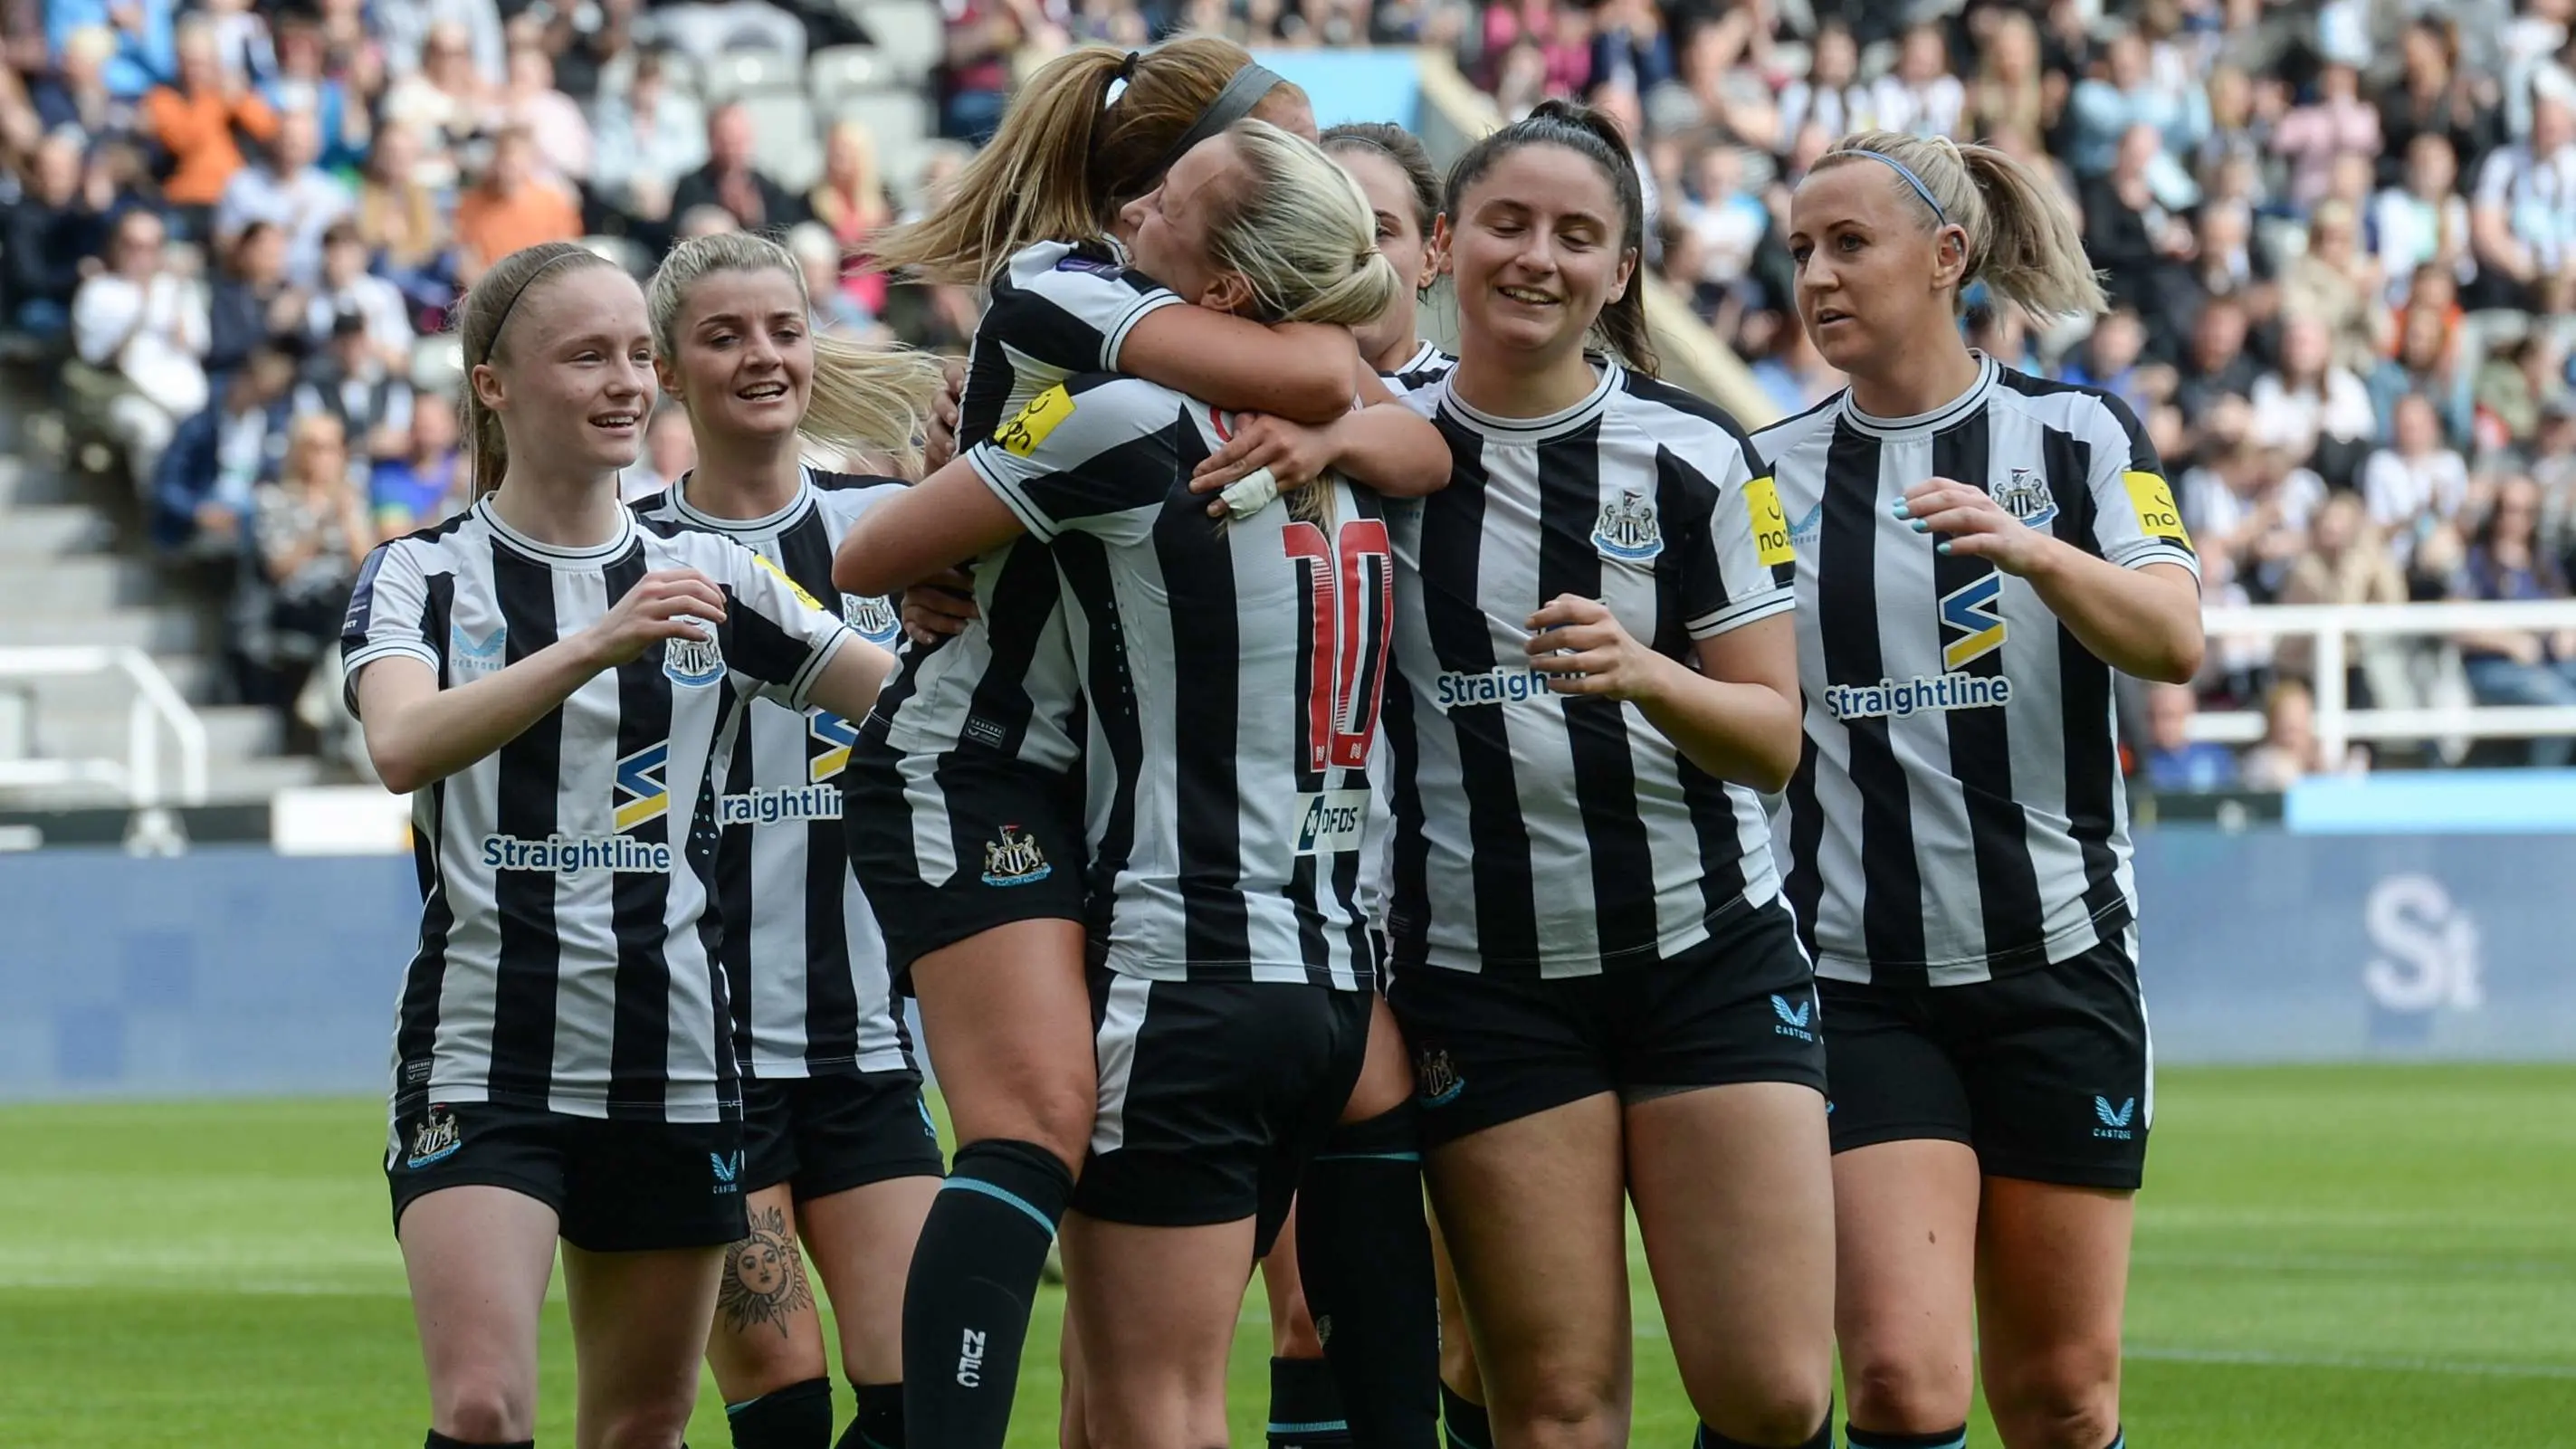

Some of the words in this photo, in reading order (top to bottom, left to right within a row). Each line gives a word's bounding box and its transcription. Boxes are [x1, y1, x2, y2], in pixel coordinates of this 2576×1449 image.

[2142, 512, 2177, 527] no
[1759, 530, 1786, 552] no
[1281, 519, 1393, 773] 10
[1437, 668, 1550, 703] Straigh
[1825, 676, 2009, 718] Straightline
[723, 787, 843, 824] raightli
[1321, 806, 1360, 834] DFDS
[483, 838, 671, 872] Straightline
[956, 1327, 987, 1388] NUFC
